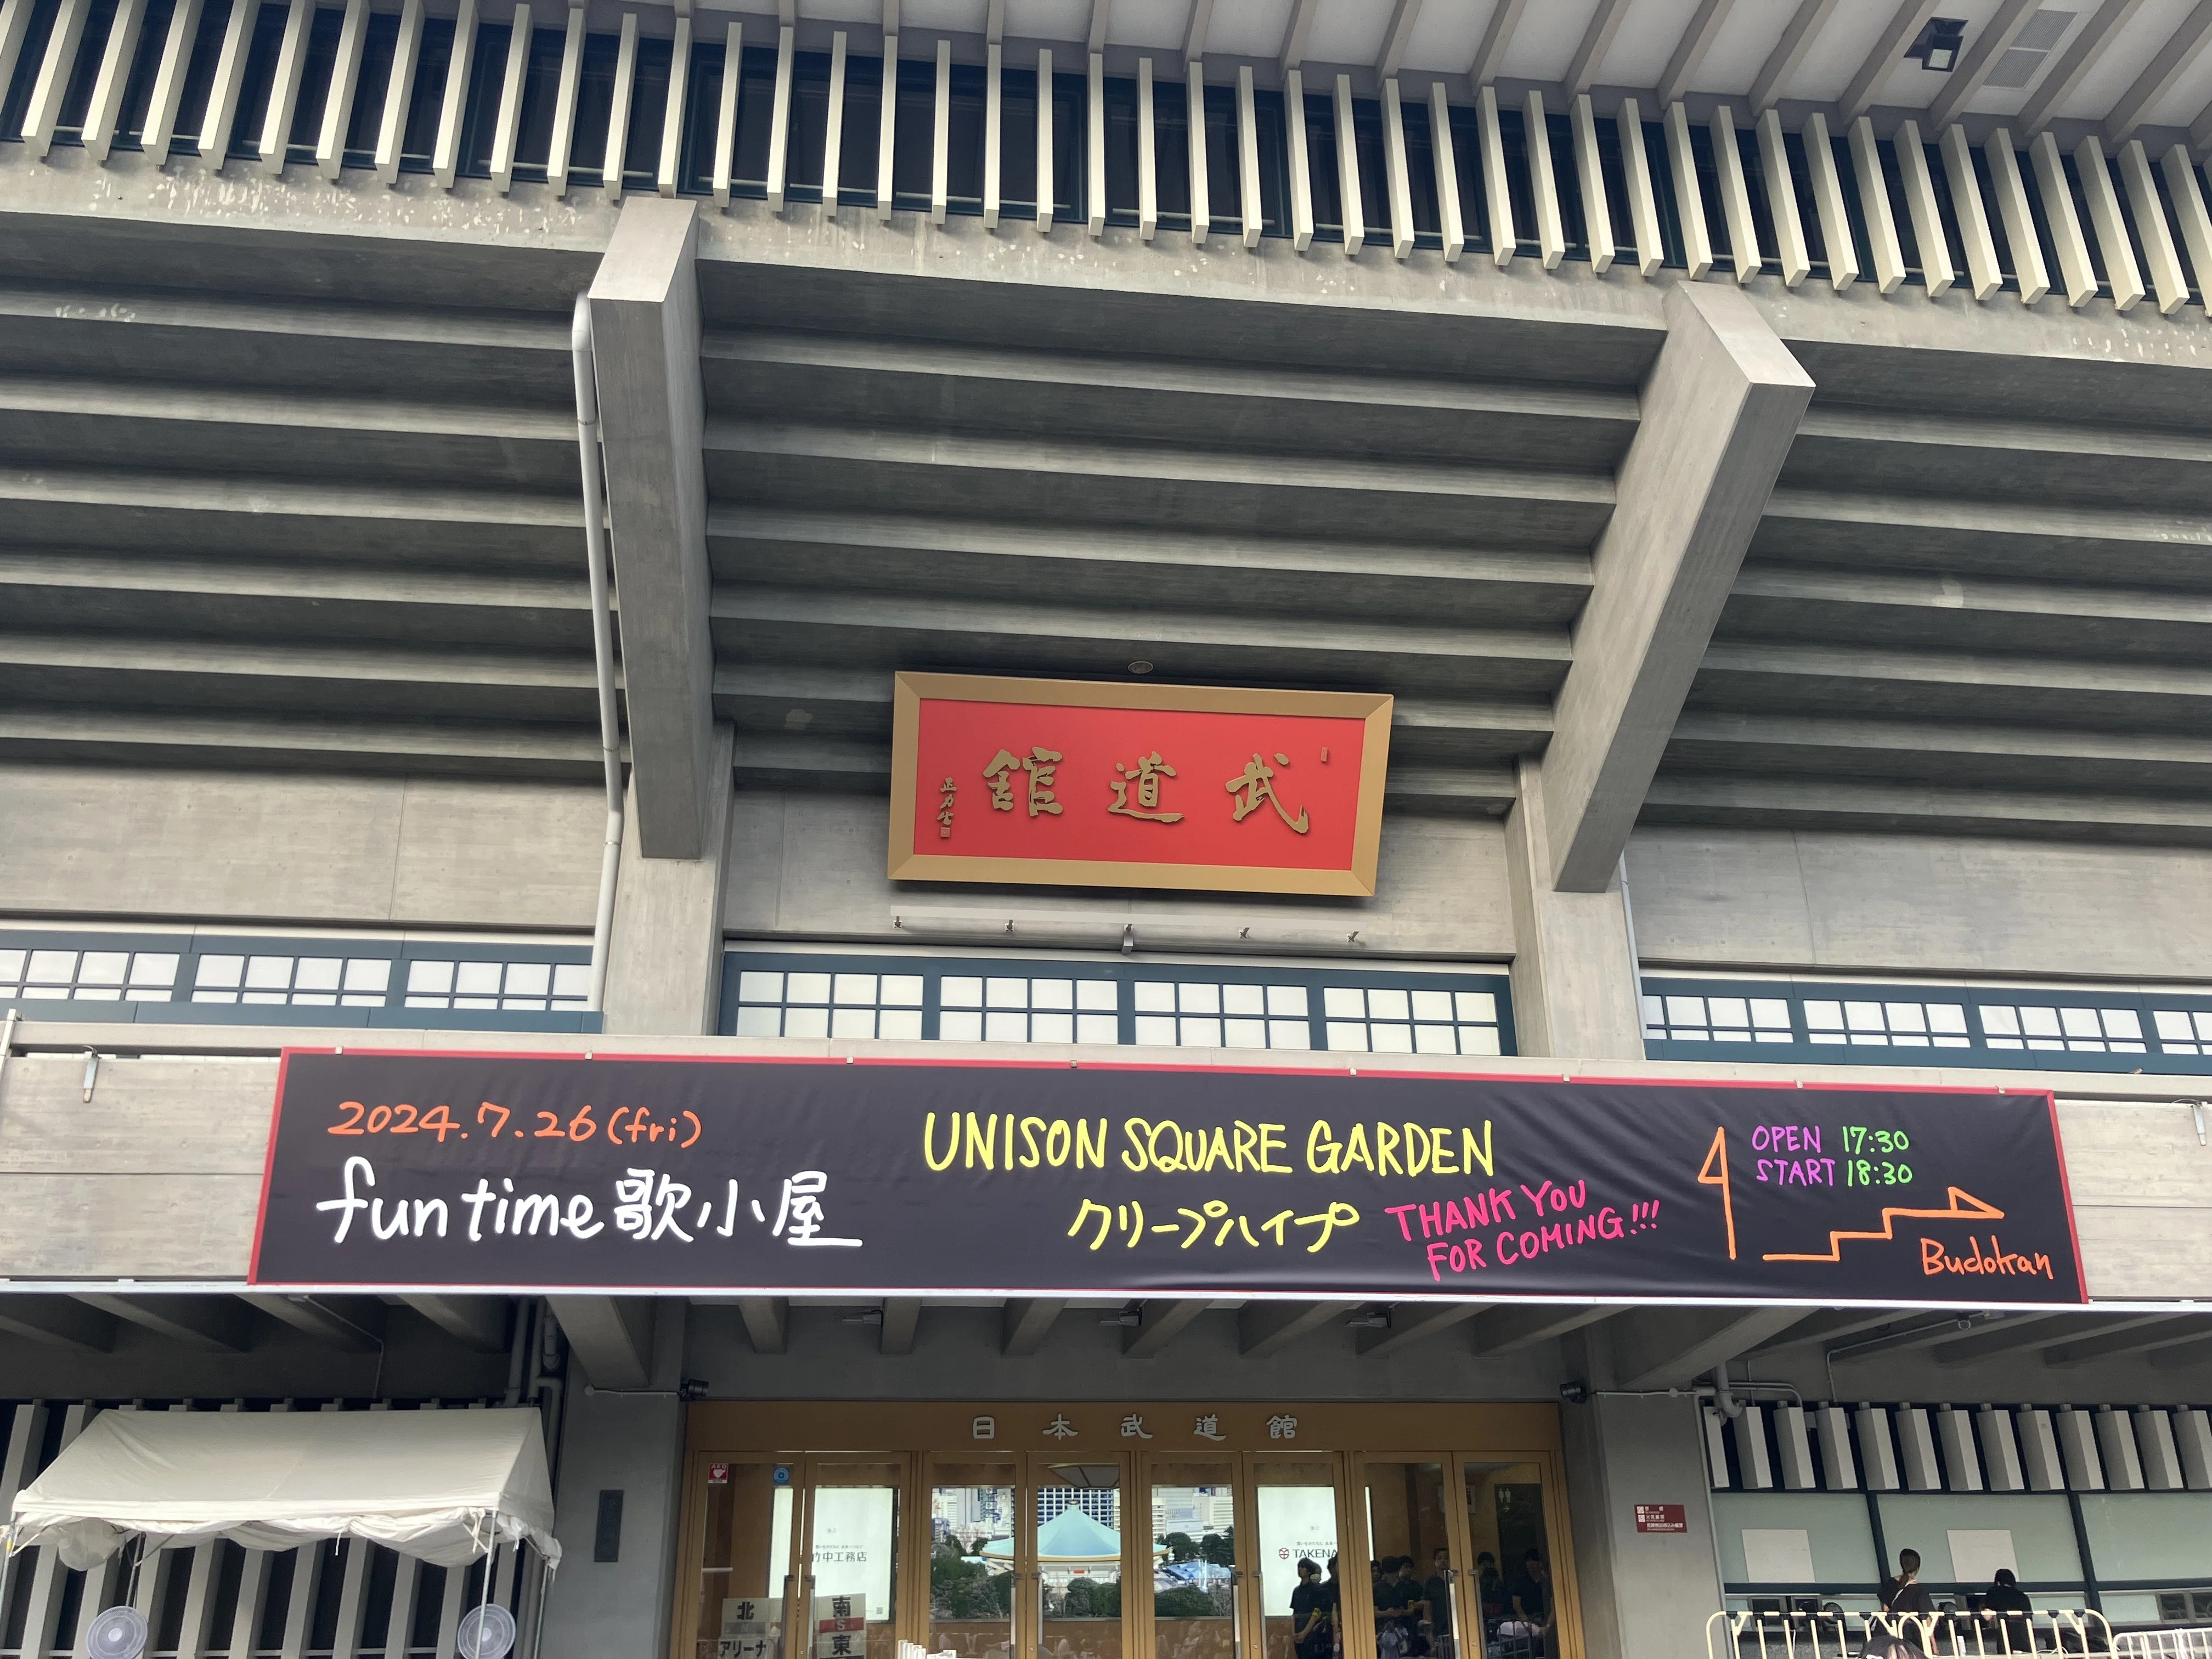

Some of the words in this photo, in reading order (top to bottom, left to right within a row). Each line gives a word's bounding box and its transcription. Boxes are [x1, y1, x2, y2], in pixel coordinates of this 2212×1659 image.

[983, 747, 1309, 833] 武道館
[924, 1111, 1108, 1171] UNISON
[1121, 1117, 1293, 1173] SQUARE
[1306, 1120, 1494, 1177] GARDEN
[1752, 1125, 1821, 1154] OPEN
[1842, 1126, 1909, 1155] 17:30
[1756, 1158, 1837, 1187] START
[1847, 1159, 1912, 1187] 18:30
[315, 1156, 448, 1244] fun
[613, 1167, 863, 1248] 歌小屋
[1384, 1188, 1516, 1242] THANK
[1520, 1179, 1586, 1217] YOU
[1067, 1198, 1360, 1253] クリープハイプ
[1426, 1238, 1487, 1282] FOR
[1497, 1199, 1660, 1265] COMING!!!
[1920, 1235, 2054, 1280] Budokan
[973, 1413, 1299, 1441] 日本武道館
[737, 1601, 754, 1620] 北
[832, 1596, 851, 1618] 南
[837, 1619, 846, 1631] S
[719, 1640, 767, 1658] アリーナ
[832, 1634, 851, 1656] 東
